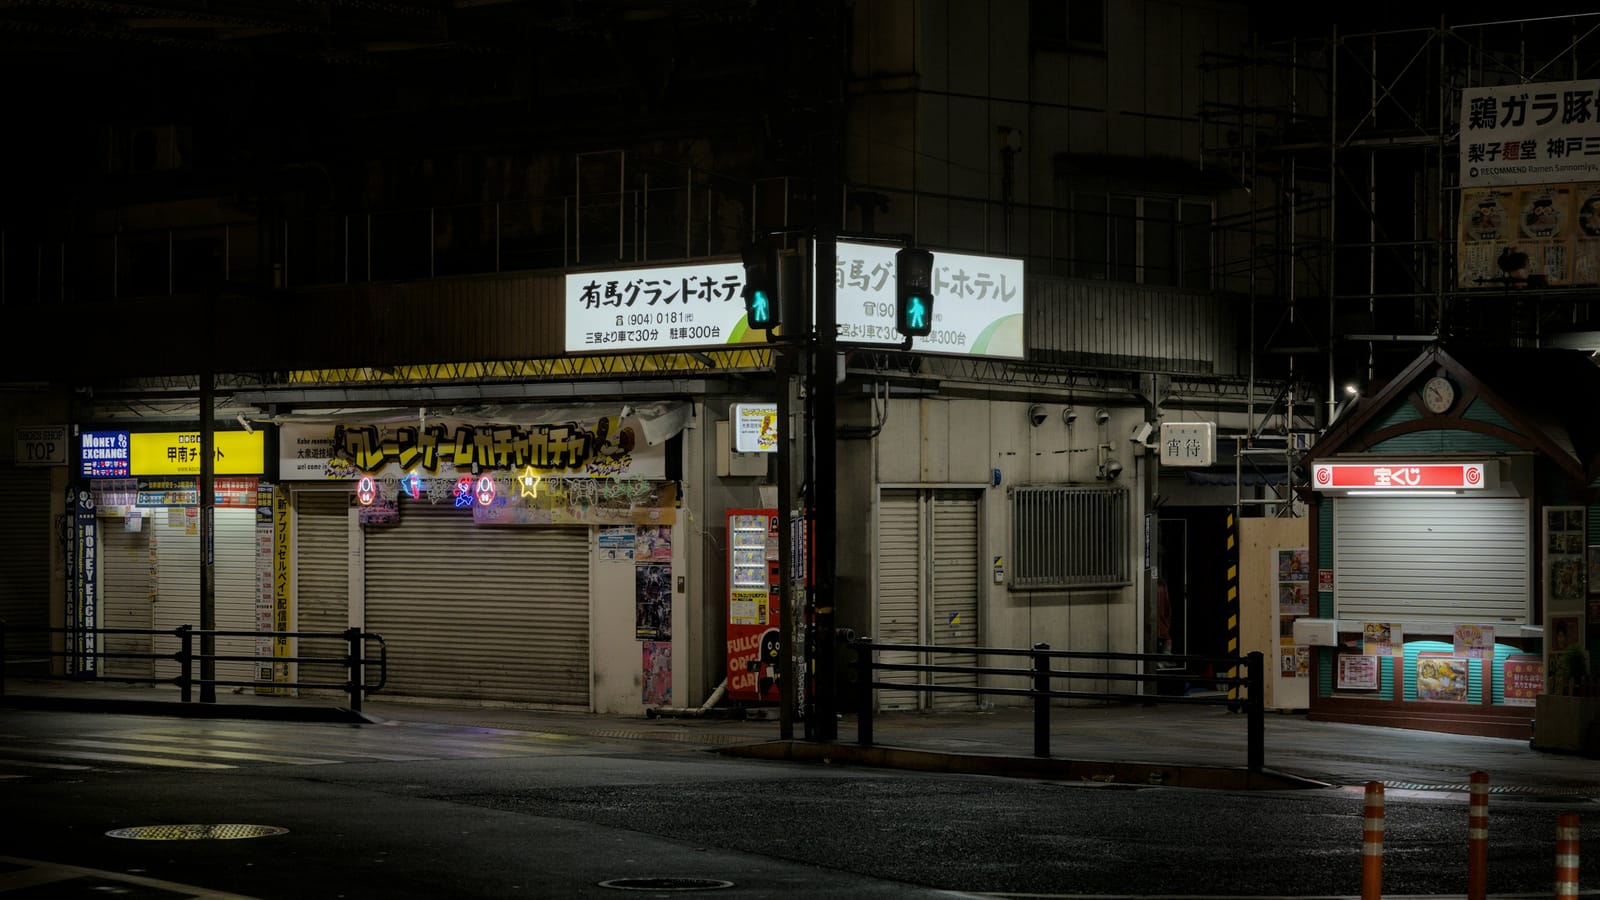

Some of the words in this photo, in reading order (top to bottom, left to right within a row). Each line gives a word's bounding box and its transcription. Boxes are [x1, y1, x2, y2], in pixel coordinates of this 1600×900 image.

[1469, 90, 1600, 130] 鶏ガラ豚
[1468, 140, 1537, 163] 梨子麺堂
[1480, 167, 1527, 176] RECOMMEND
[1528, 165, 1554, 173] Ramen
[627, 314, 653, 326] (904)
[585, 331, 659, 344] 三宮より車で30分
[669, 326, 720, 339] 駐車300台
[82, 434, 115, 448] MONEY
[26, 443, 55, 460] TOP
[82, 449, 127, 459] EXCHANGE
[167, 446, 225, 463] 甲南チト
[1374, 467, 1421, 486] 宝くじ
[85, 524, 94, 581] MONEY
